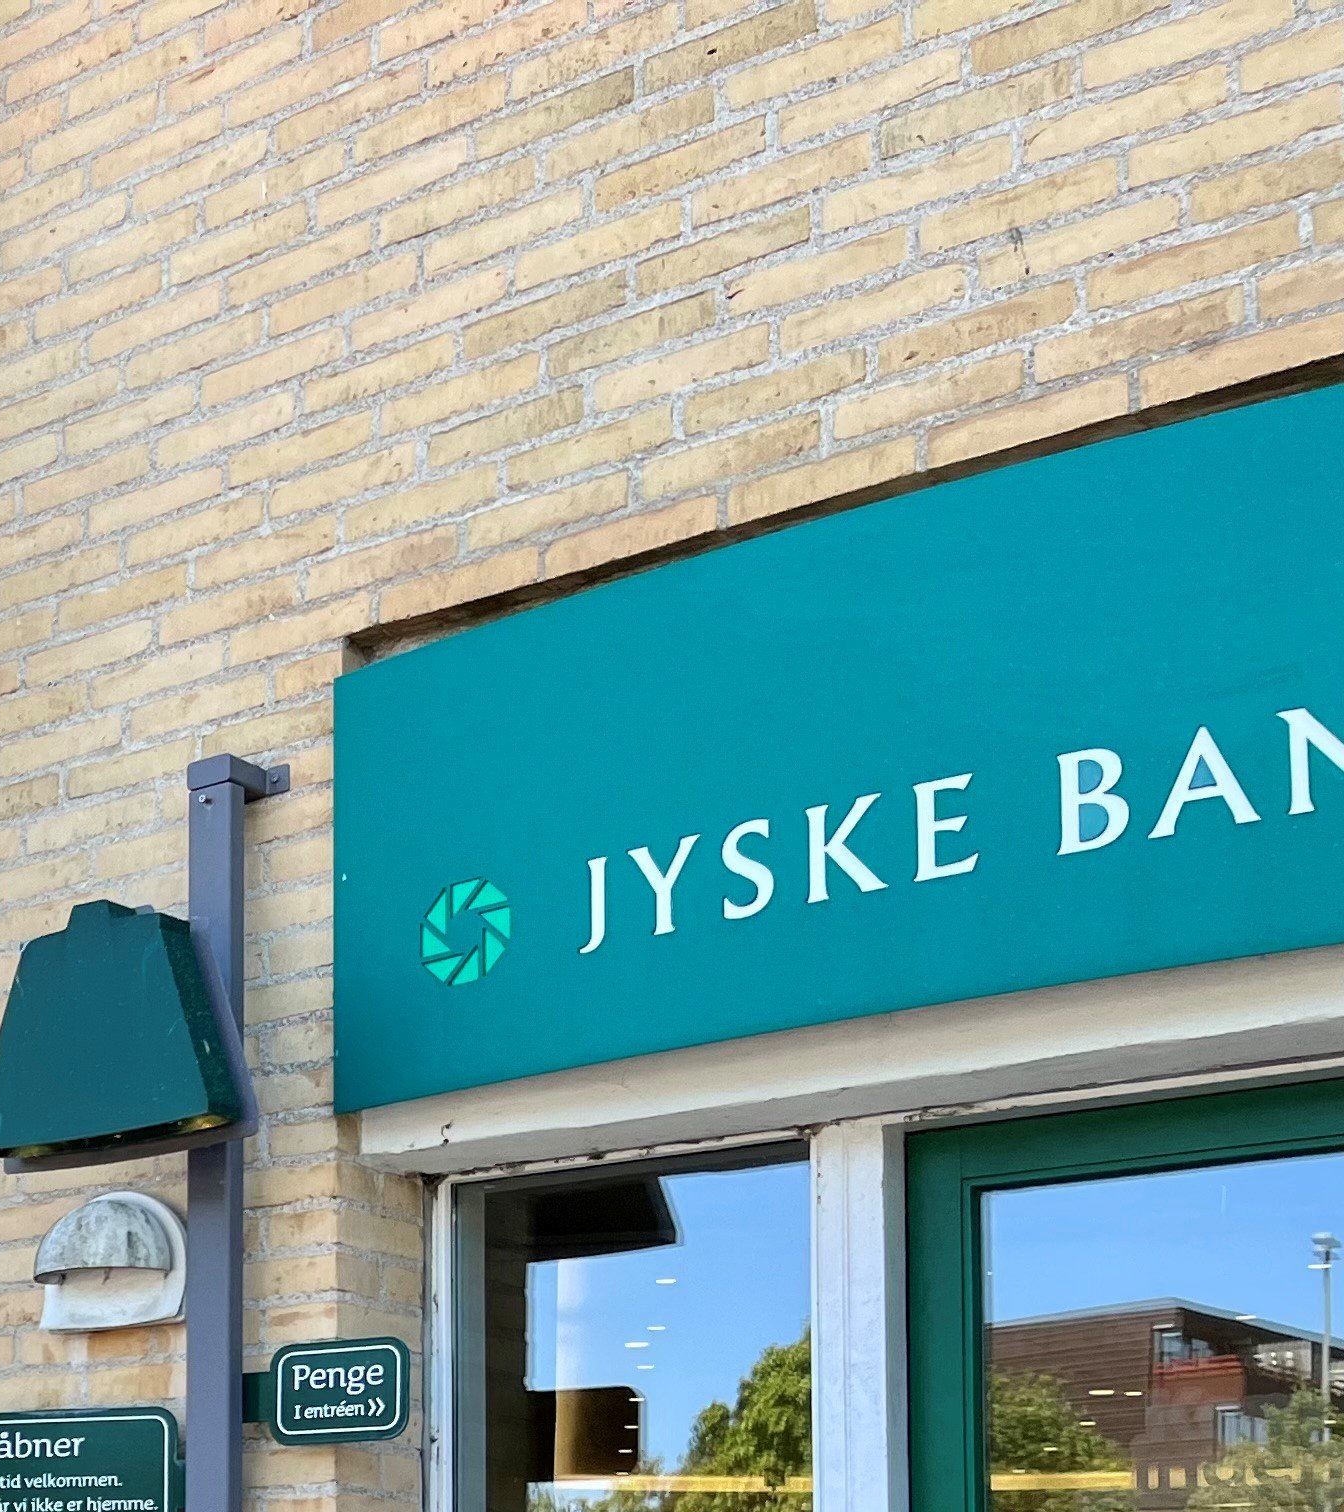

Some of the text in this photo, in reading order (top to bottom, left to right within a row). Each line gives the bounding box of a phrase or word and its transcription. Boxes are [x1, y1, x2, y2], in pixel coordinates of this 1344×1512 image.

[580, 772, 979, 954] JYSKE
[292, 1364, 384, 1395] Penge
[293, 1400, 365, 1420] I entréen
[24, 1473, 123, 1489] velkommen.
[13, 1498, 27, 1512] vi
[31, 1497, 63, 1512] ikke
[66, 1499, 83, 1512] er
